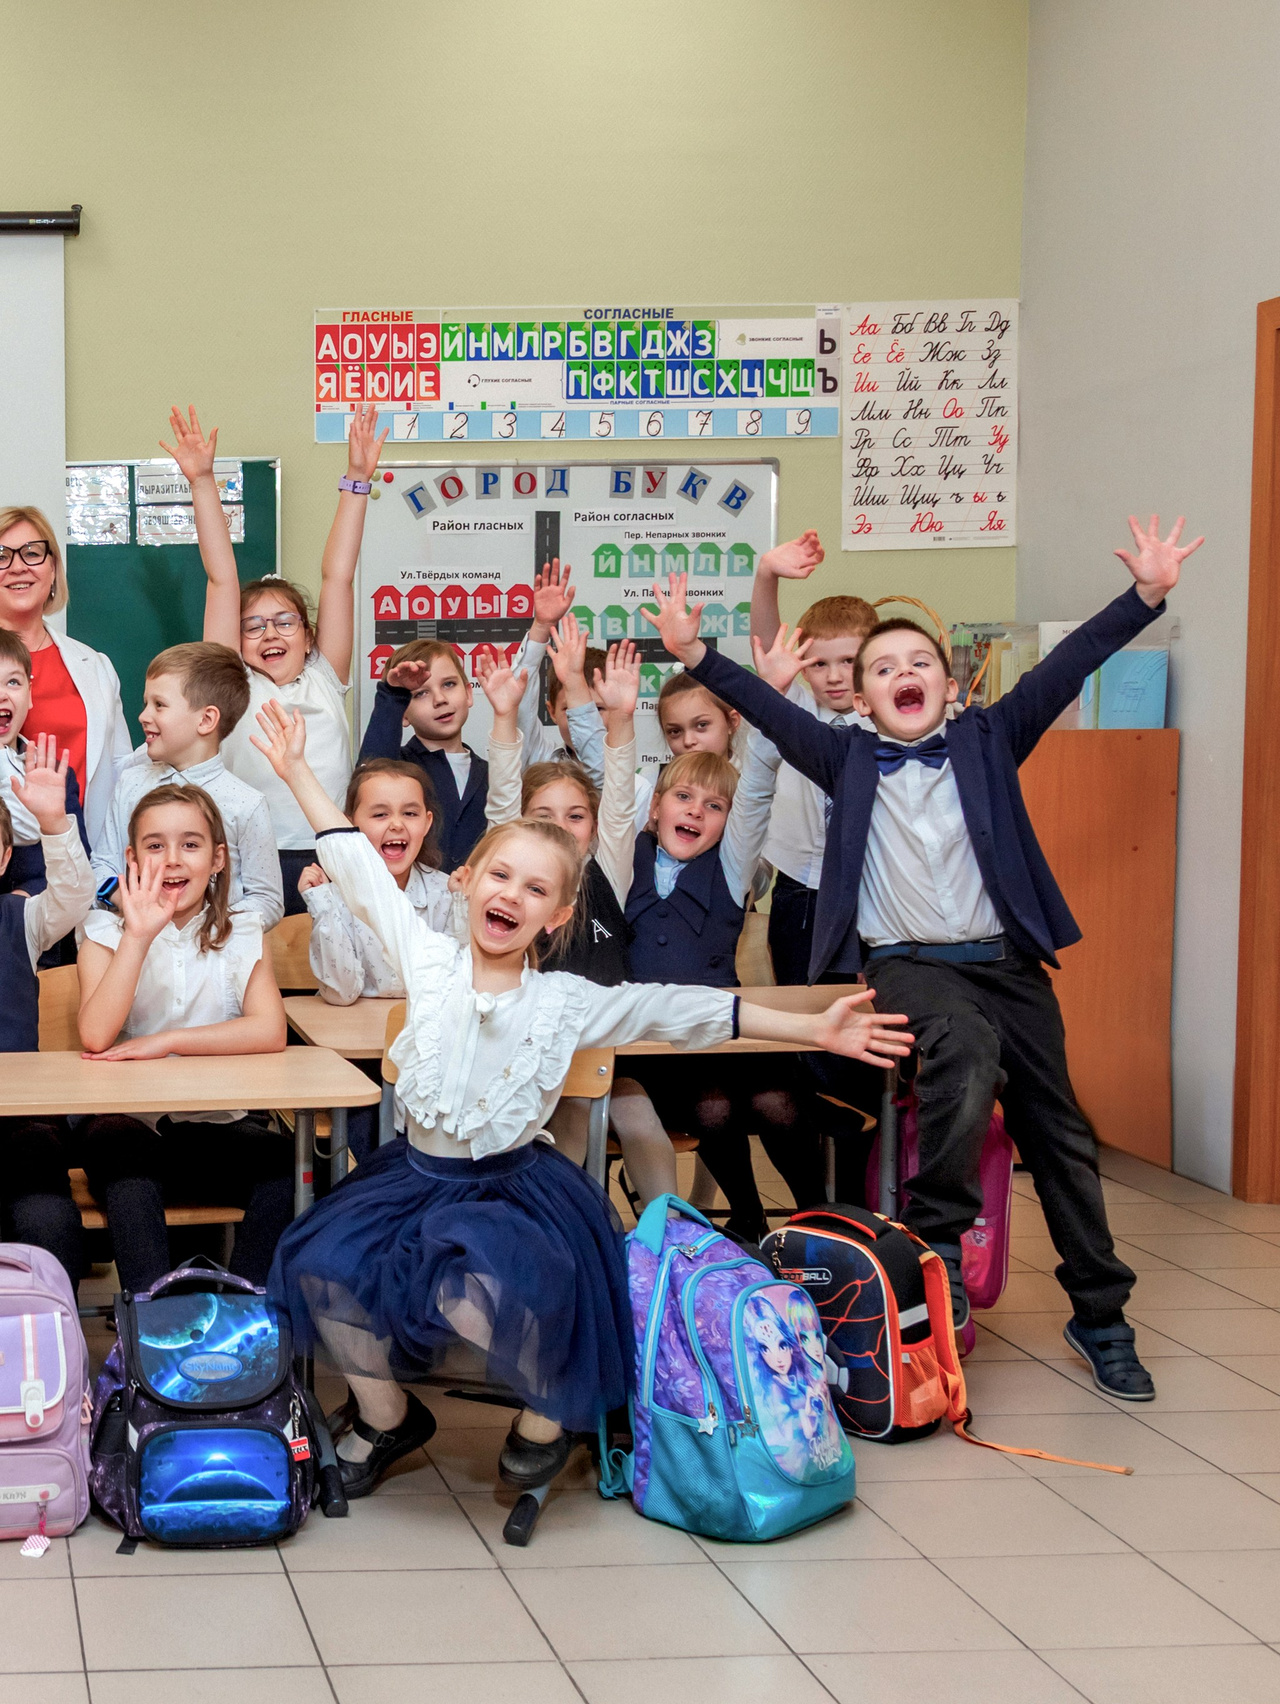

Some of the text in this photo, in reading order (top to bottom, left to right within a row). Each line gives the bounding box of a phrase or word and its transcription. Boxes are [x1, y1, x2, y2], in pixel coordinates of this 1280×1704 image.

[341, 311, 413, 323] ГЛАСНЫЕ
[583, 308, 674, 320] СОГЛАСНЫЕ
[819, 328, 837, 355] Ь
[817, 367, 838, 394] Ъ
[406, 409, 812, 439] 1 2 3 4 5 6 7 8 9
[407, 469, 748, 513] ГОРОД БУКВ
[574, 511, 675, 522] Район согласных
[432, 519, 524, 531] Район гласных
[624, 530, 727, 541] Пер. Непарных звонких
[400, 570, 501, 581] Ул.Твёрдых команд
[623, 589, 639, 598] Ул.
[641, 755, 661, 763] Пер.
[781, 1272, 829, 1281] OOTBALL
